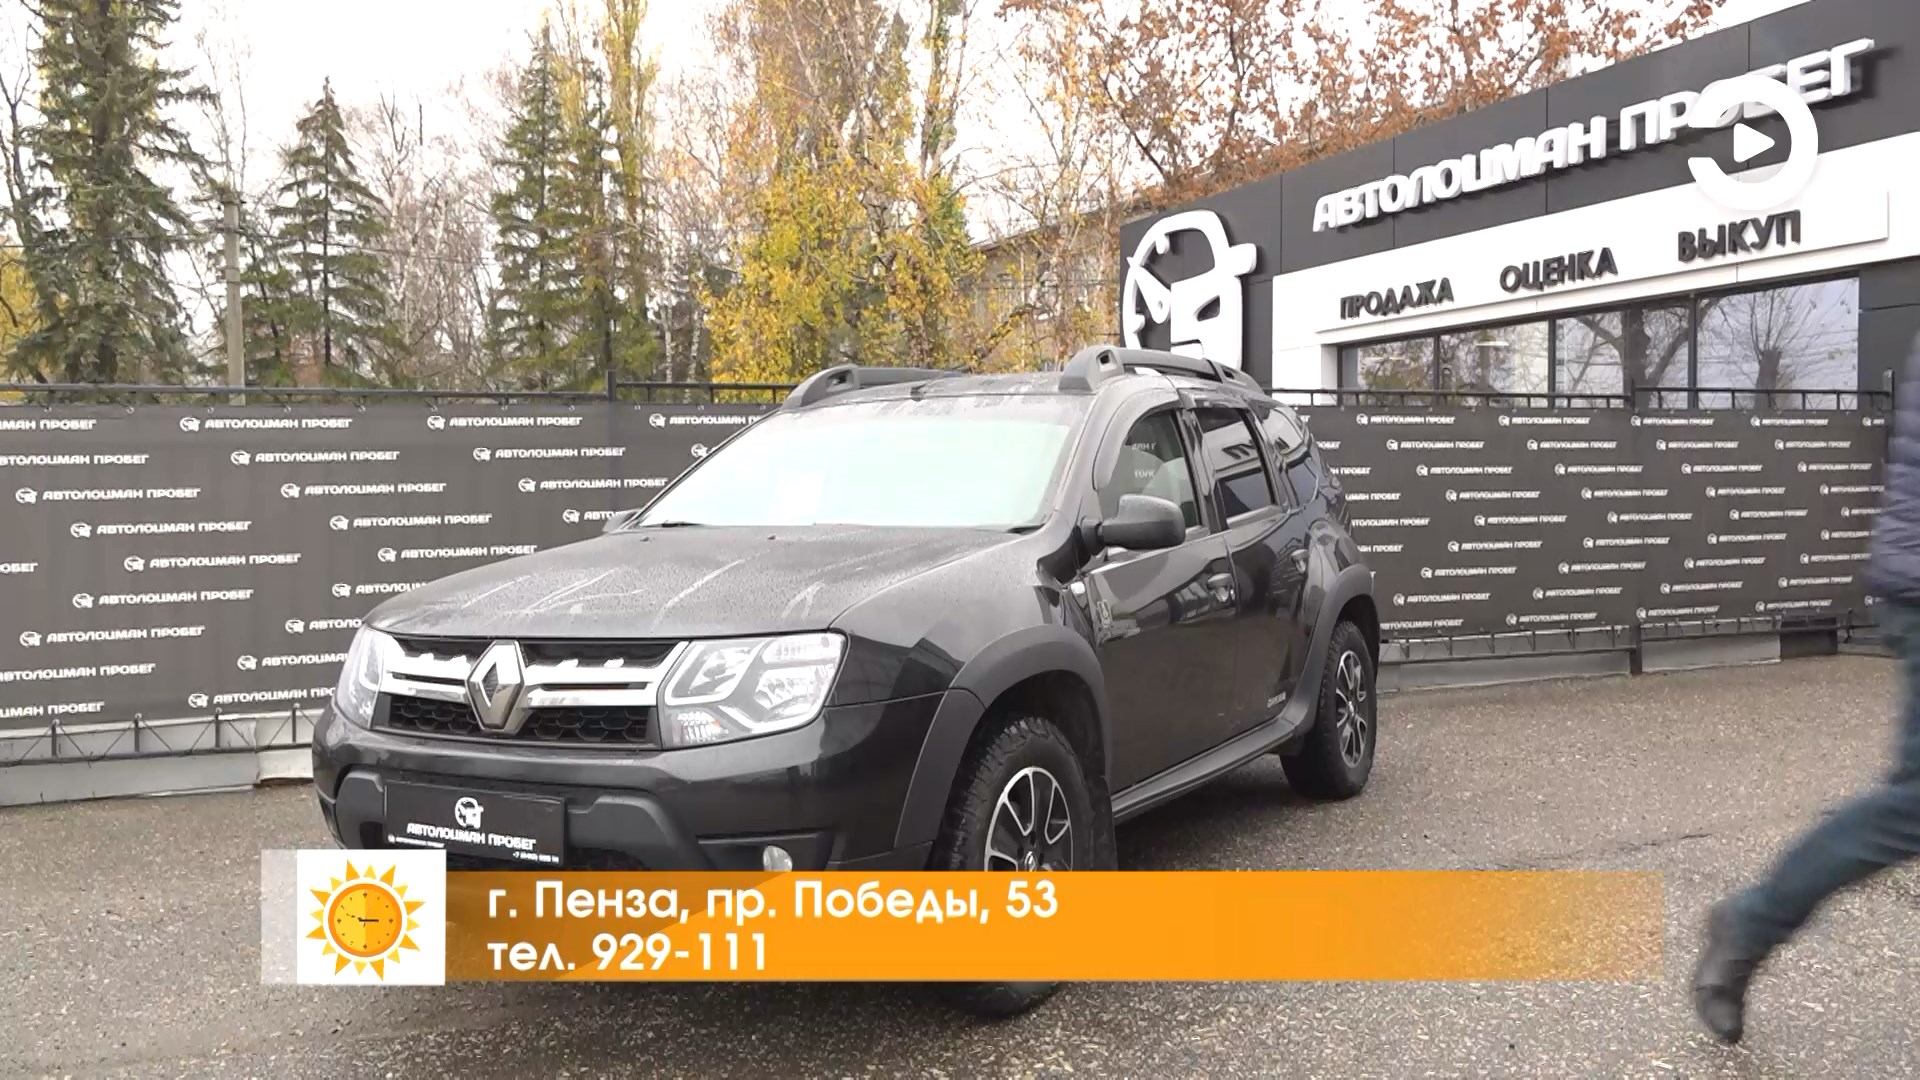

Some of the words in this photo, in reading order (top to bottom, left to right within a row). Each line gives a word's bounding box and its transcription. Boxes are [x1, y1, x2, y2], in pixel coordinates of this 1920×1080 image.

[1313, 114, 1608, 232] АВТОЛОЦМАН
[1678, 210, 1801, 263] ВЫКУП
[1500, 247, 1618, 294] ОЦЕНКА
[1340, 277, 1454, 320] ПРОДАЖА
[40, 419, 96, 430] ПРОБЕГ
[205, 419, 298, 429] АВТОЛОЦМАН
[302, 419, 352, 428] ПРОБЕГ
[449, 417, 534, 427] АВТОЛОЦМАН
[537, 416, 583, 426] ПРОБЕГ
[669, 416, 745, 425] АВТОЛОЦМАН
[255, 452, 347, 462] АВТОЛОЦМАН
[350, 451, 400, 460] ПРОБЕГ
[496, 449, 578, 458] АВТОЛОЦМАН
[581, 447, 626, 456] ПРОБЕГ
[0, 454, 90, 465] ВТОЛОЦМАН
[94, 454, 149, 464] ПРОБЕГ
[305, 484, 394, 495] АВТОЛОЦМАН
[398, 483, 446, 493] ПРОБЕГ
[540, 479, 621, 489] АВТОЛОЦМАН
[624, 478, 668, 487] ПРОБЕГ
[43, 489, 143, 500] АВТОЛОЦМАН
[147, 487, 201, 498] ПРОБЕГ
[353, 516, 441, 527] АВТОЛОЦМАН
[444, 514, 492, 524] ПРОБЕГ
[97, 523, 195, 534] АВТОЛОЦМАН
[198, 521, 252, 532] ПРОБЕГ
[401, 547, 487, 558] АВТОЛОЦМАН
[490, 545, 537, 555] ПРОБЕГ
[150, 556, 246, 568] АВТОЛОЦМАН
[249, 553, 301, 564] ПРОБЕГ
[99, 592, 197, 604] АВТОЛОЦМАН
[200, 589, 254, 600] ПРОБЕГ
[309, 618, 363, 630] АВТОЛО
[47, 629, 147, 643] АВТОЛОЦМАН
[151, 626, 205, 638] ПРОБЕГ
[100, 663, 156, 675] ПРОБЕГ
[214, 691, 307, 704] АВТОЛОЦМАН
[48, 702, 104, 714] ПРОБЕГ
[488, 833, 536, 850] ПРОБЕГ
